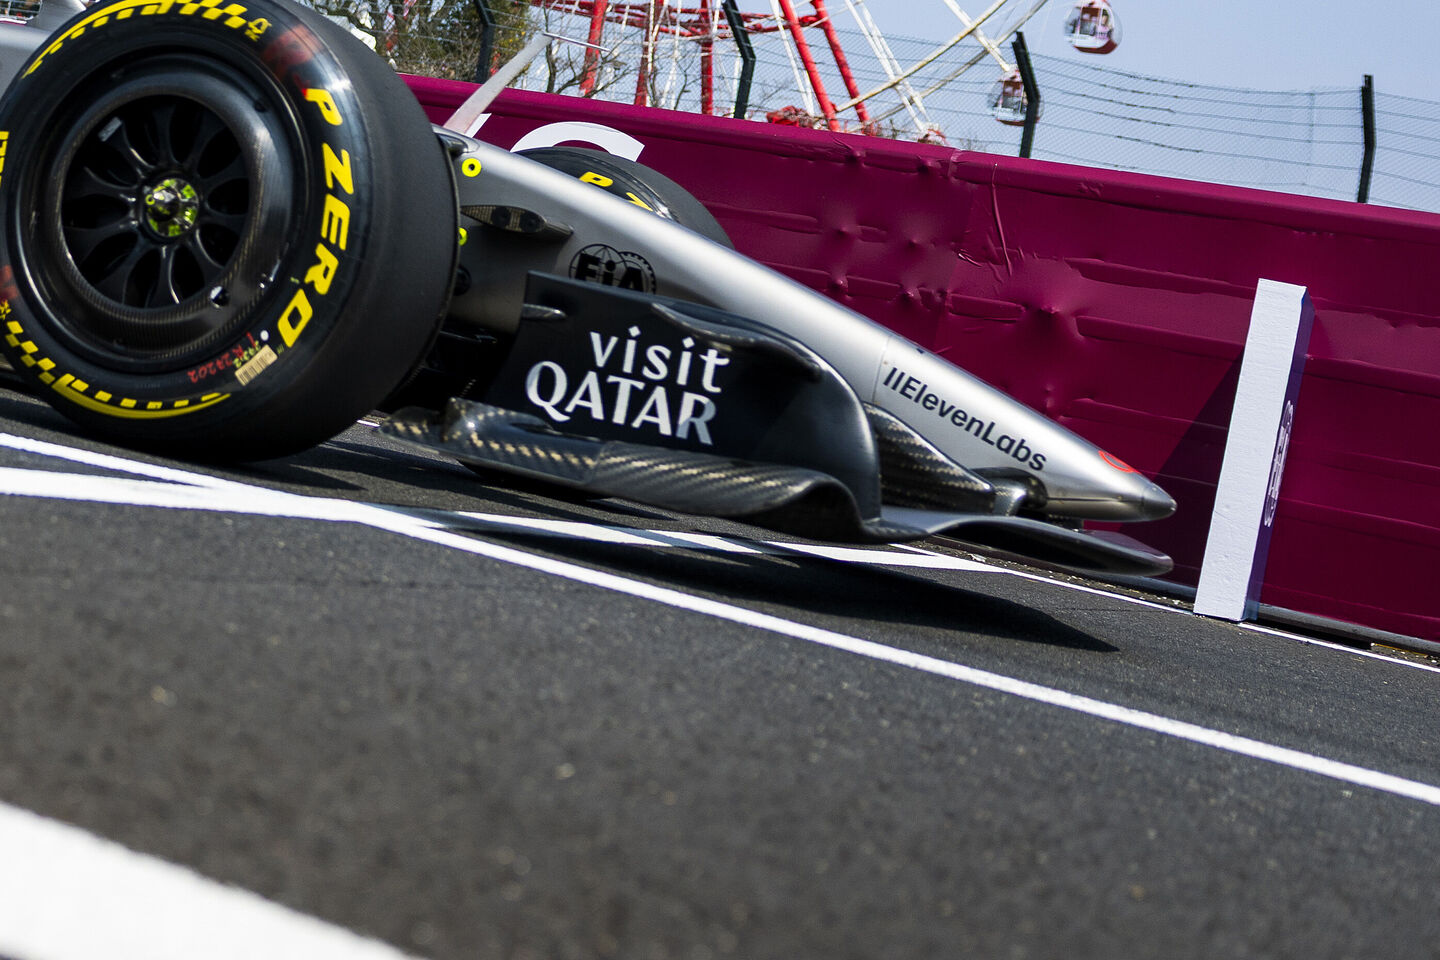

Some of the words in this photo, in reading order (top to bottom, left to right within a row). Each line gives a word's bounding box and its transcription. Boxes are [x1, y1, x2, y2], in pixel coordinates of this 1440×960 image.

[302, 88, 343, 126] P
[277, 143, 354, 348] ZERO
[590, 326, 730, 393] visit
[525, 361, 717, 446] QATAR
